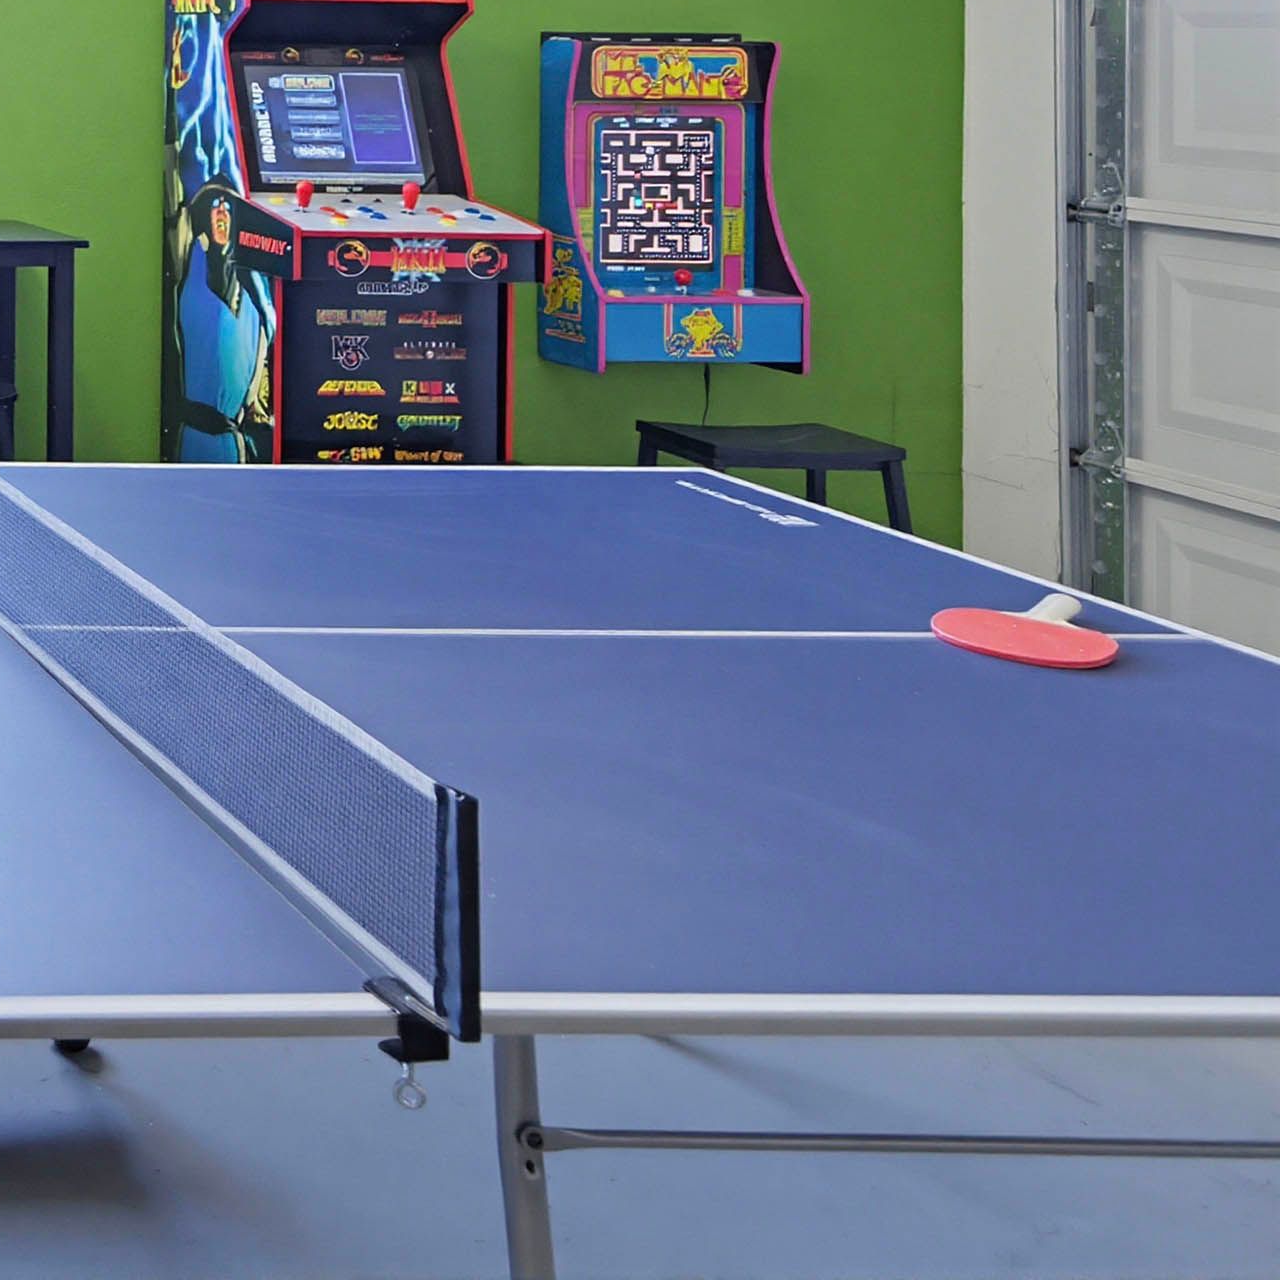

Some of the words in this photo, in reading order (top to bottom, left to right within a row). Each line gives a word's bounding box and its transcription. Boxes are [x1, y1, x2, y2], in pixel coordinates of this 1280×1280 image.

[239, 231, 287, 255] MIDWAY
[323, 410, 378, 430] JOUST
[396, 414, 463, 431] GAUNTLET
